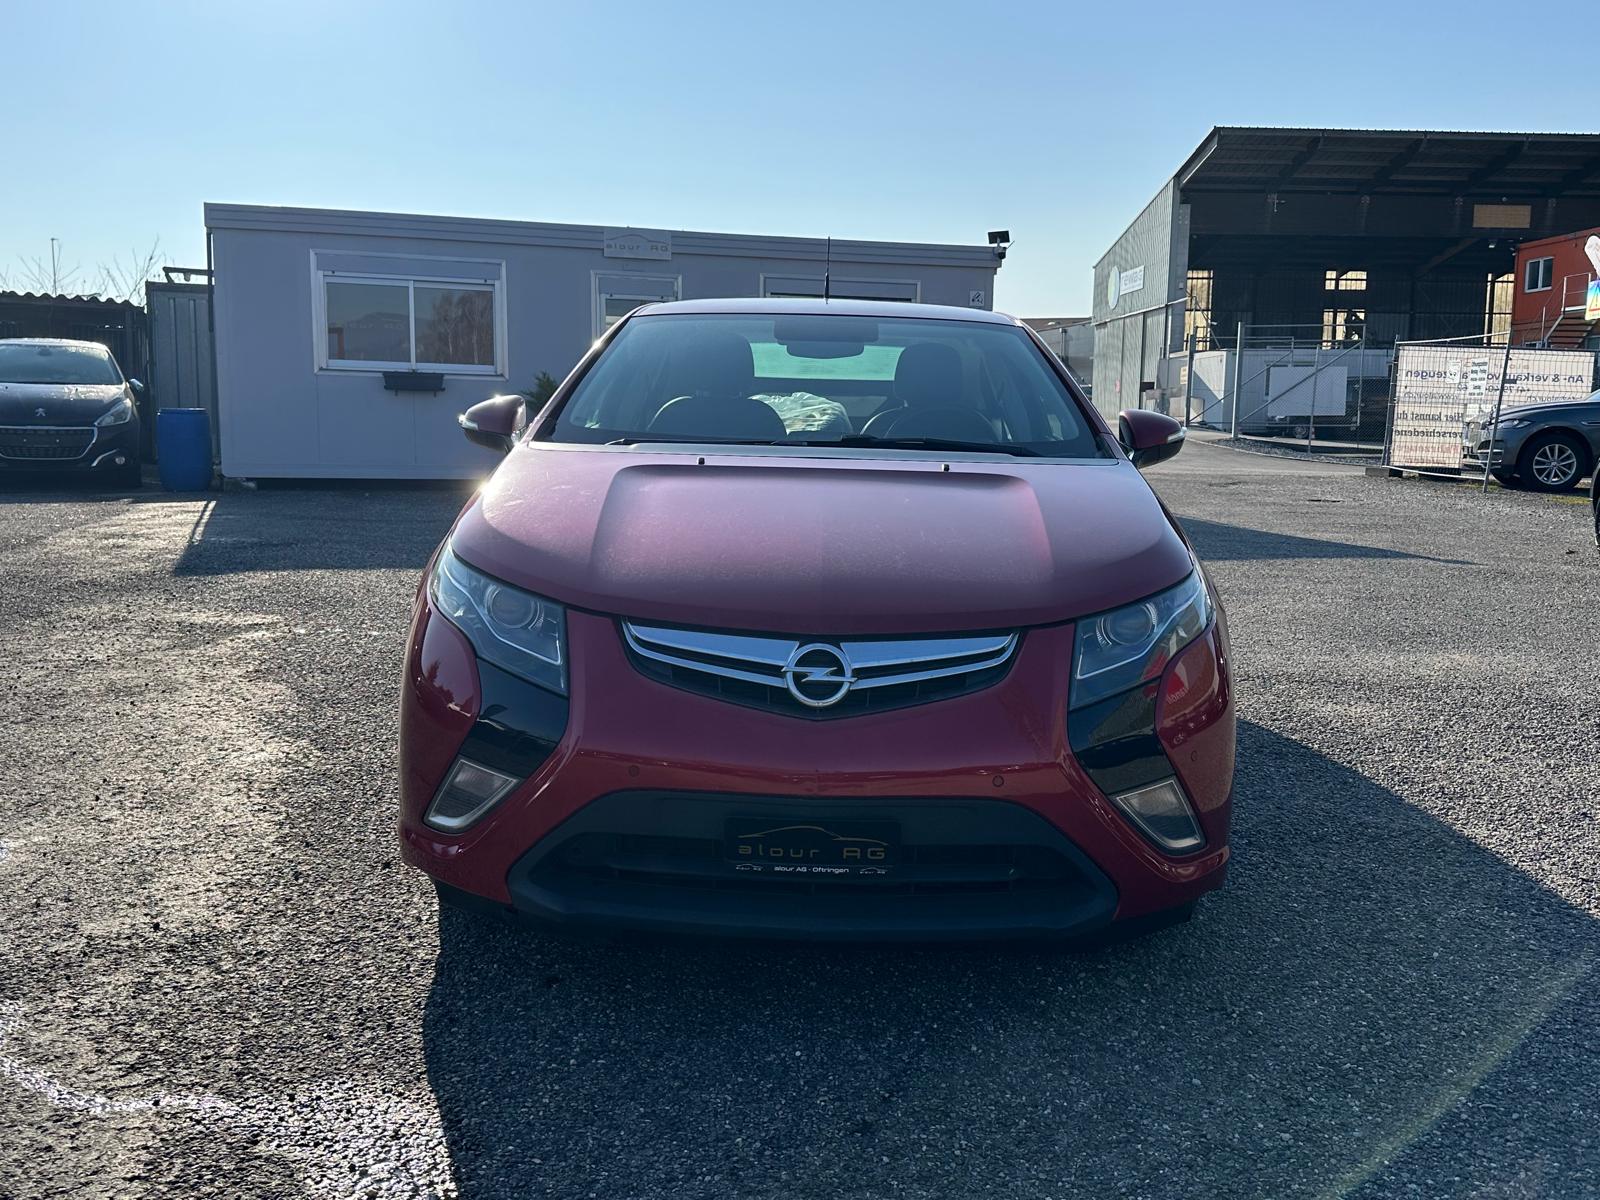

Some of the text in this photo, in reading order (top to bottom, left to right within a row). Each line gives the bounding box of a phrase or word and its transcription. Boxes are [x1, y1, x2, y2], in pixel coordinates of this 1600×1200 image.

[738, 844, 885, 860] alour AG
[812, 866, 849, 874] Oftringen
